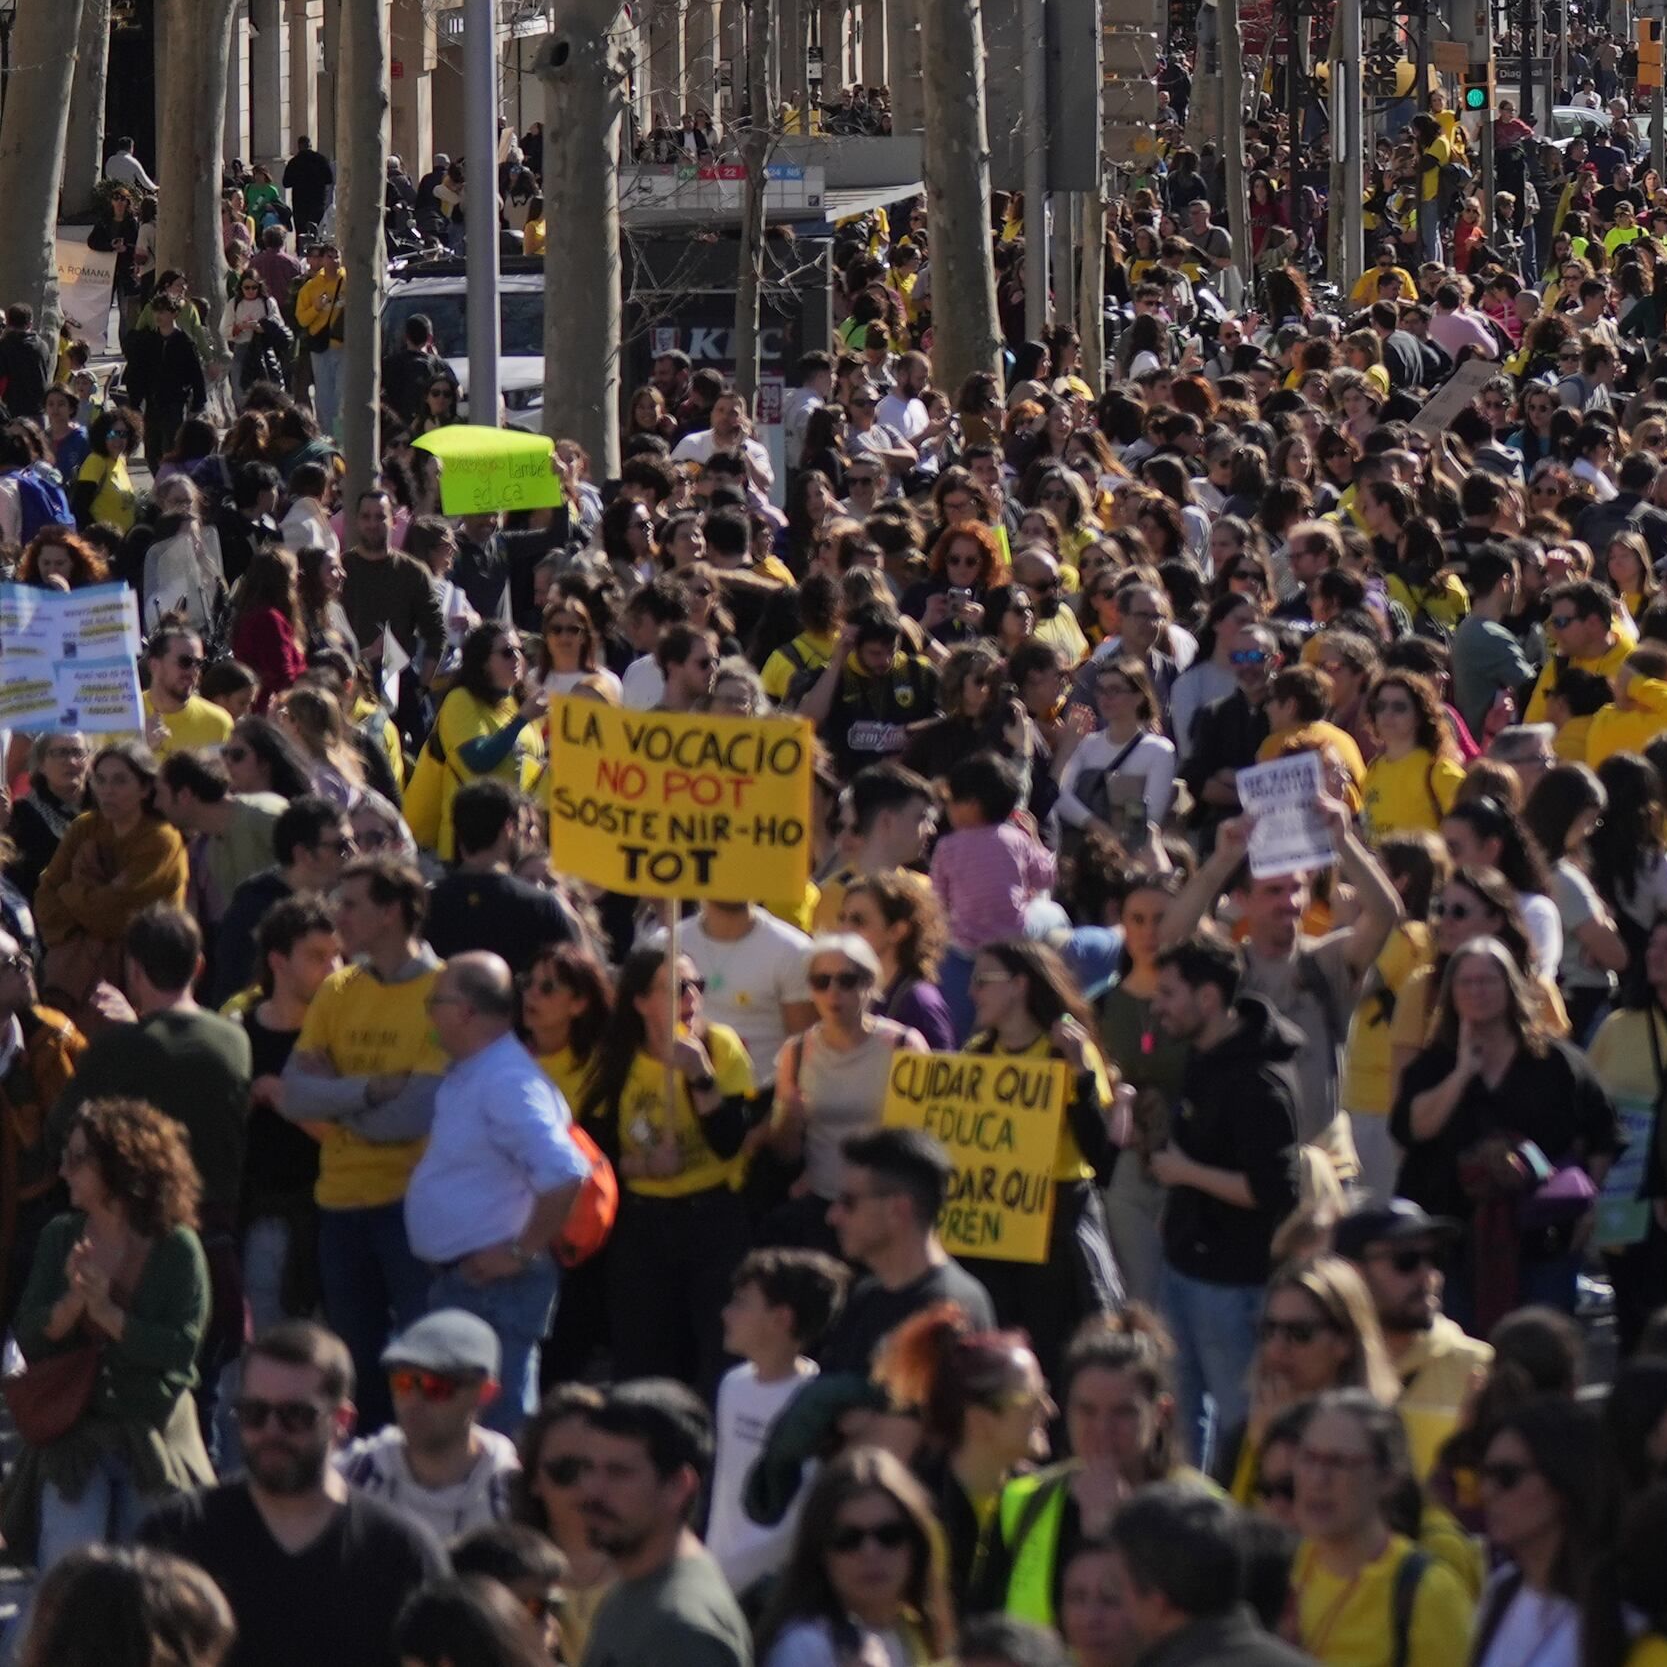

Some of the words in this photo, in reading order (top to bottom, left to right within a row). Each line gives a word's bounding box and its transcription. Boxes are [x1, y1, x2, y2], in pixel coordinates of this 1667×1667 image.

[722, 167, 737, 177] 22
[67, 265, 111, 279] ROMANA
[559, 705, 604, 749] LA
[621, 717, 804, 777] VOCACIÓ
[597, 758, 647, 801] NO
[662, 770, 757, 810] POT
[552, 786, 804, 846] SOSTENIR-HO
[617, 844, 719, 886] TOT
[891, 1060, 982, 1111] CUIDAR
[923, 1107, 1015, 1154] EDUCA
